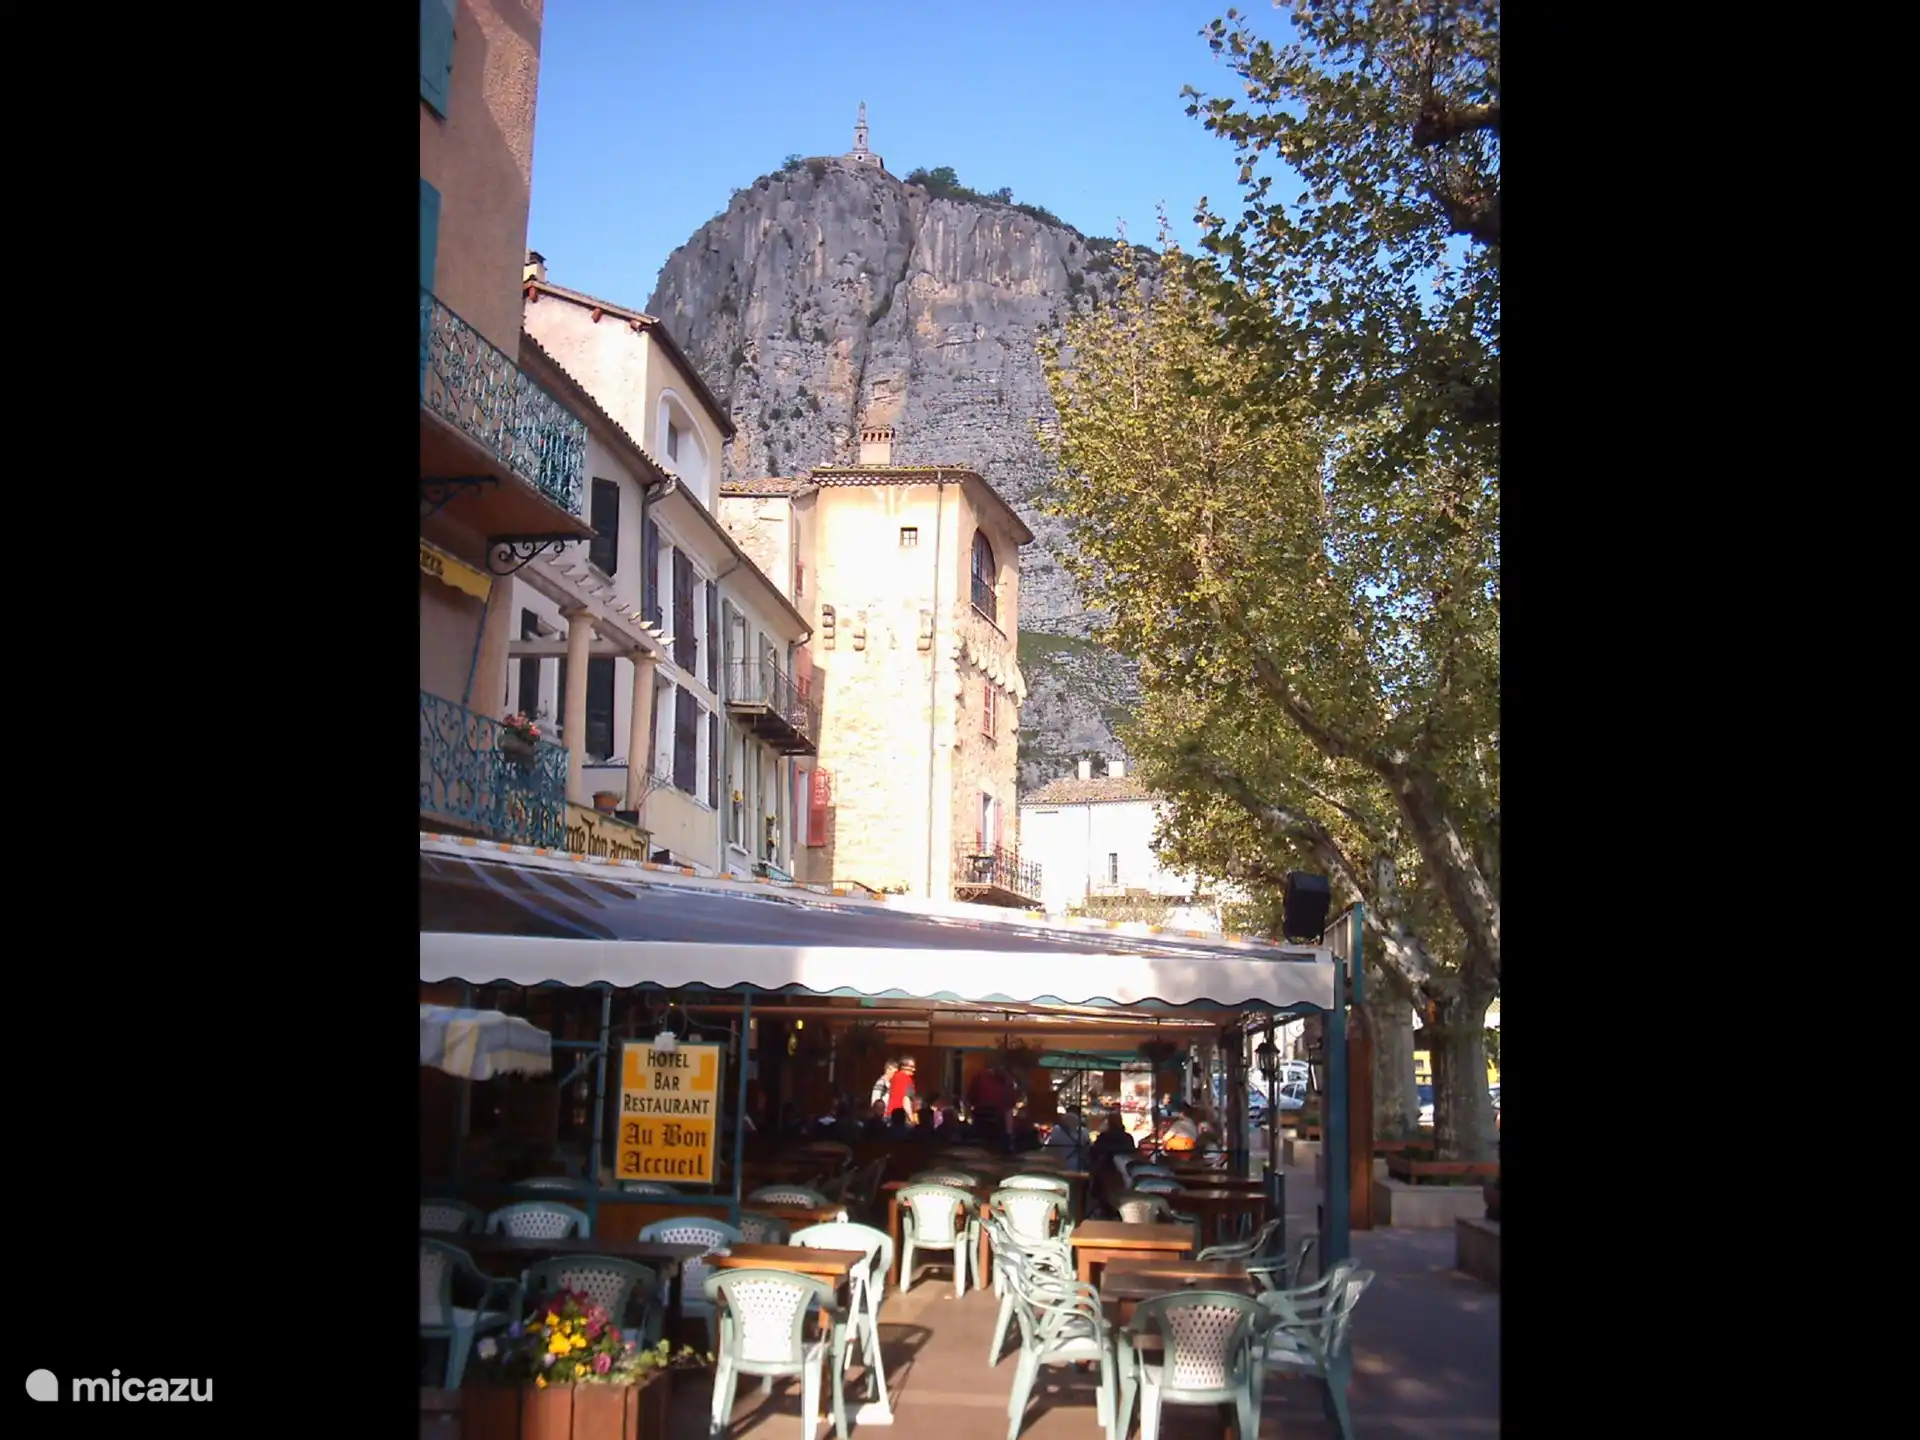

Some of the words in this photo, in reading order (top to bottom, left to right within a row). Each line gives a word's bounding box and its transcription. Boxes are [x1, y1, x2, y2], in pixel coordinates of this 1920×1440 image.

[647, 1049, 690, 1068] HOTEL
[654, 1072, 680, 1091] BAR
[623, 1094, 710, 1114] RESTAURANT
[624, 1122, 653, 1146] Au
[662, 1123, 707, 1148] Bon
[623, 1150, 705, 1176] Accueil
